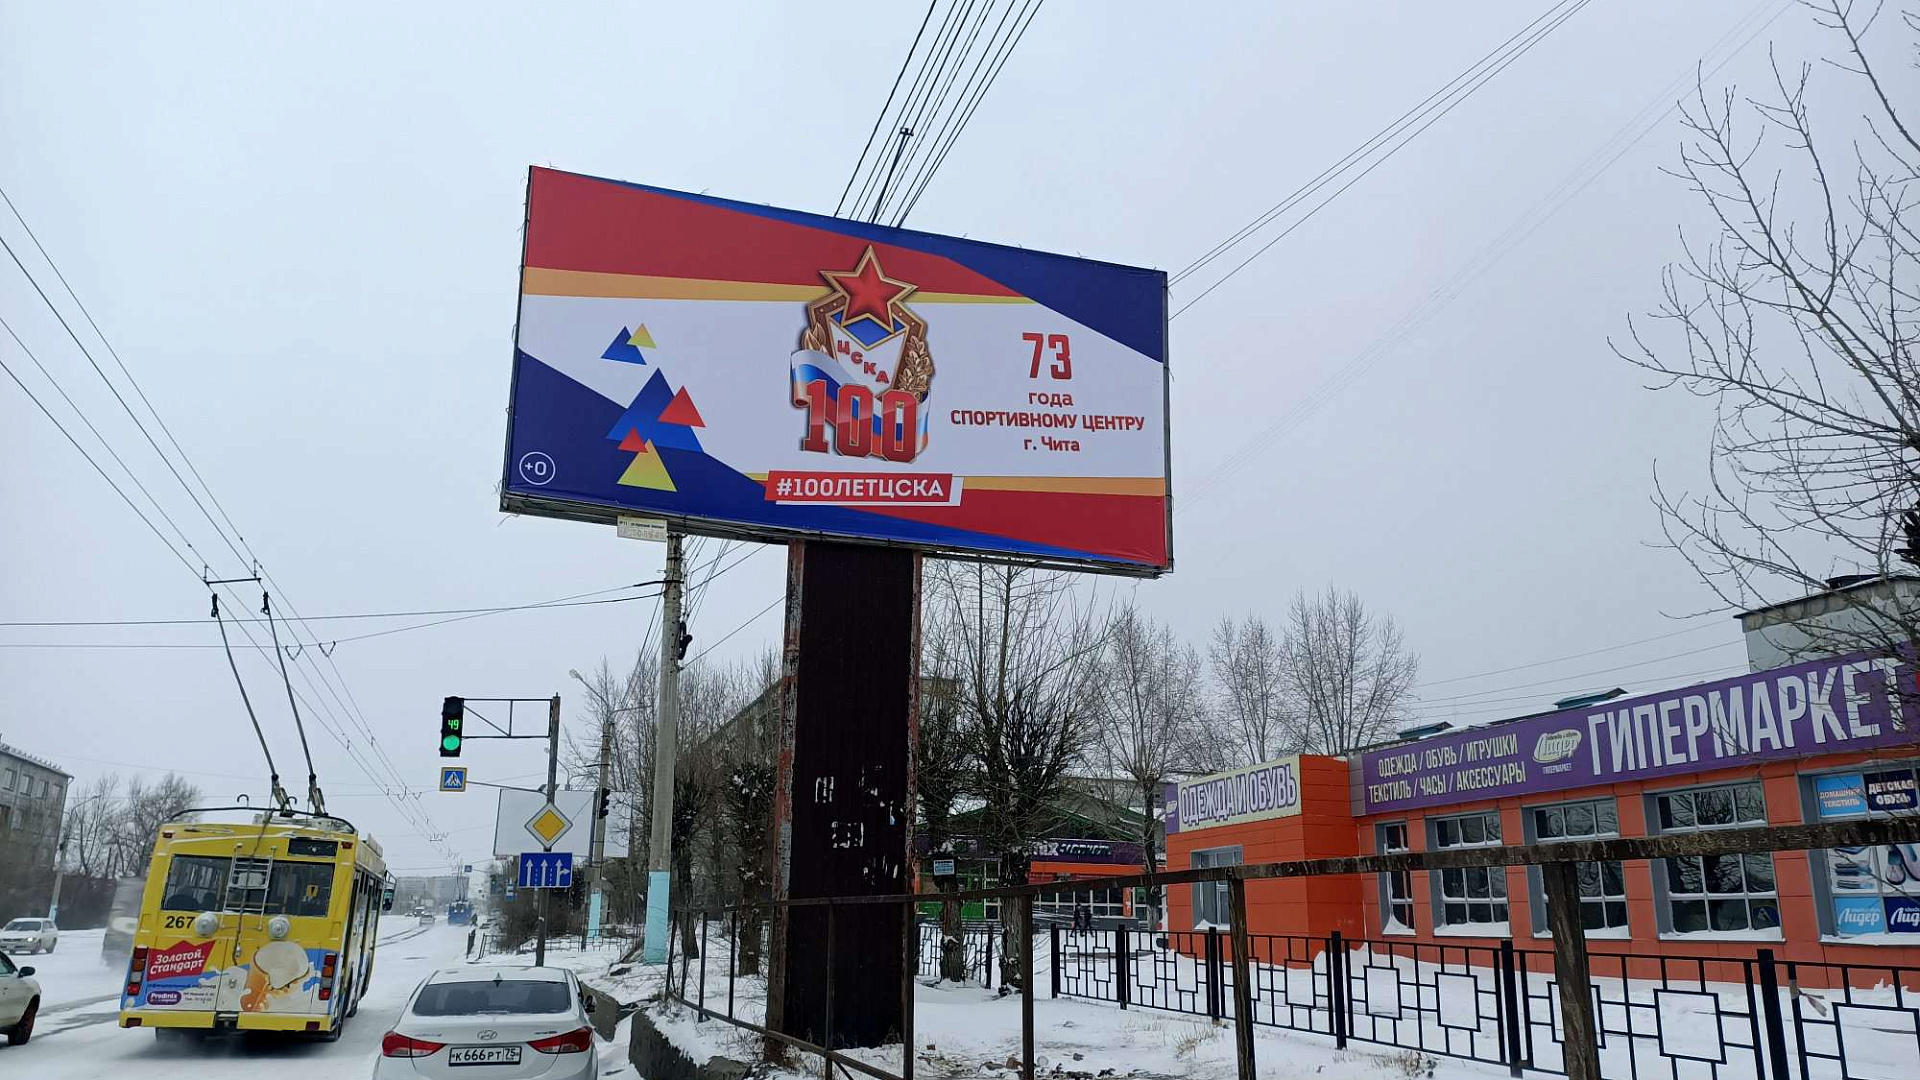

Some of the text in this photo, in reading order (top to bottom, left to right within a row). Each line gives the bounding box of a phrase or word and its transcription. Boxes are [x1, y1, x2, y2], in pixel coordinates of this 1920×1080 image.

[838, 339, 890, 384] ЦСКА
[1022, 332, 1073, 380] 73
[1028, 391, 1074, 408] года
[806, 379, 920, 462] 100
[950, 409, 1145, 432] СПОРТИВНОМУ ЦЕНТРУ
[1023, 435, 1081, 452] г. Чита
[776, 477, 944, 499] #100ЛЕТЦСКА
[447, 719, 460, 730] 49
[1587, 657, 1906, 776] ГИПЕРМАРКЕТ
[1378, 754, 1418, 778] ОДЕЖДА
[1425, 746, 1457, 770] ОБУВЬ
[1466, 733, 1519, 761] ИГРУШКИ
[1368, 778, 1412, 804] ТЕКСТИЛЬ
[1419, 770, 1447, 796] ЧАСЫ
[1456, 761, 1526, 791] АКСЕССУАРЫ
[1181, 778, 1234, 825] ОДЕЖДА
[1236, 773, 1247, 816] И
[1249, 764, 1297, 812] ОБУВЬ
[165, 915, 196, 929] 267
[1838, 906, 1880, 927] Лидер
[150, 960, 204, 974] Стандарт
[155, 949, 203, 964] Золотой
